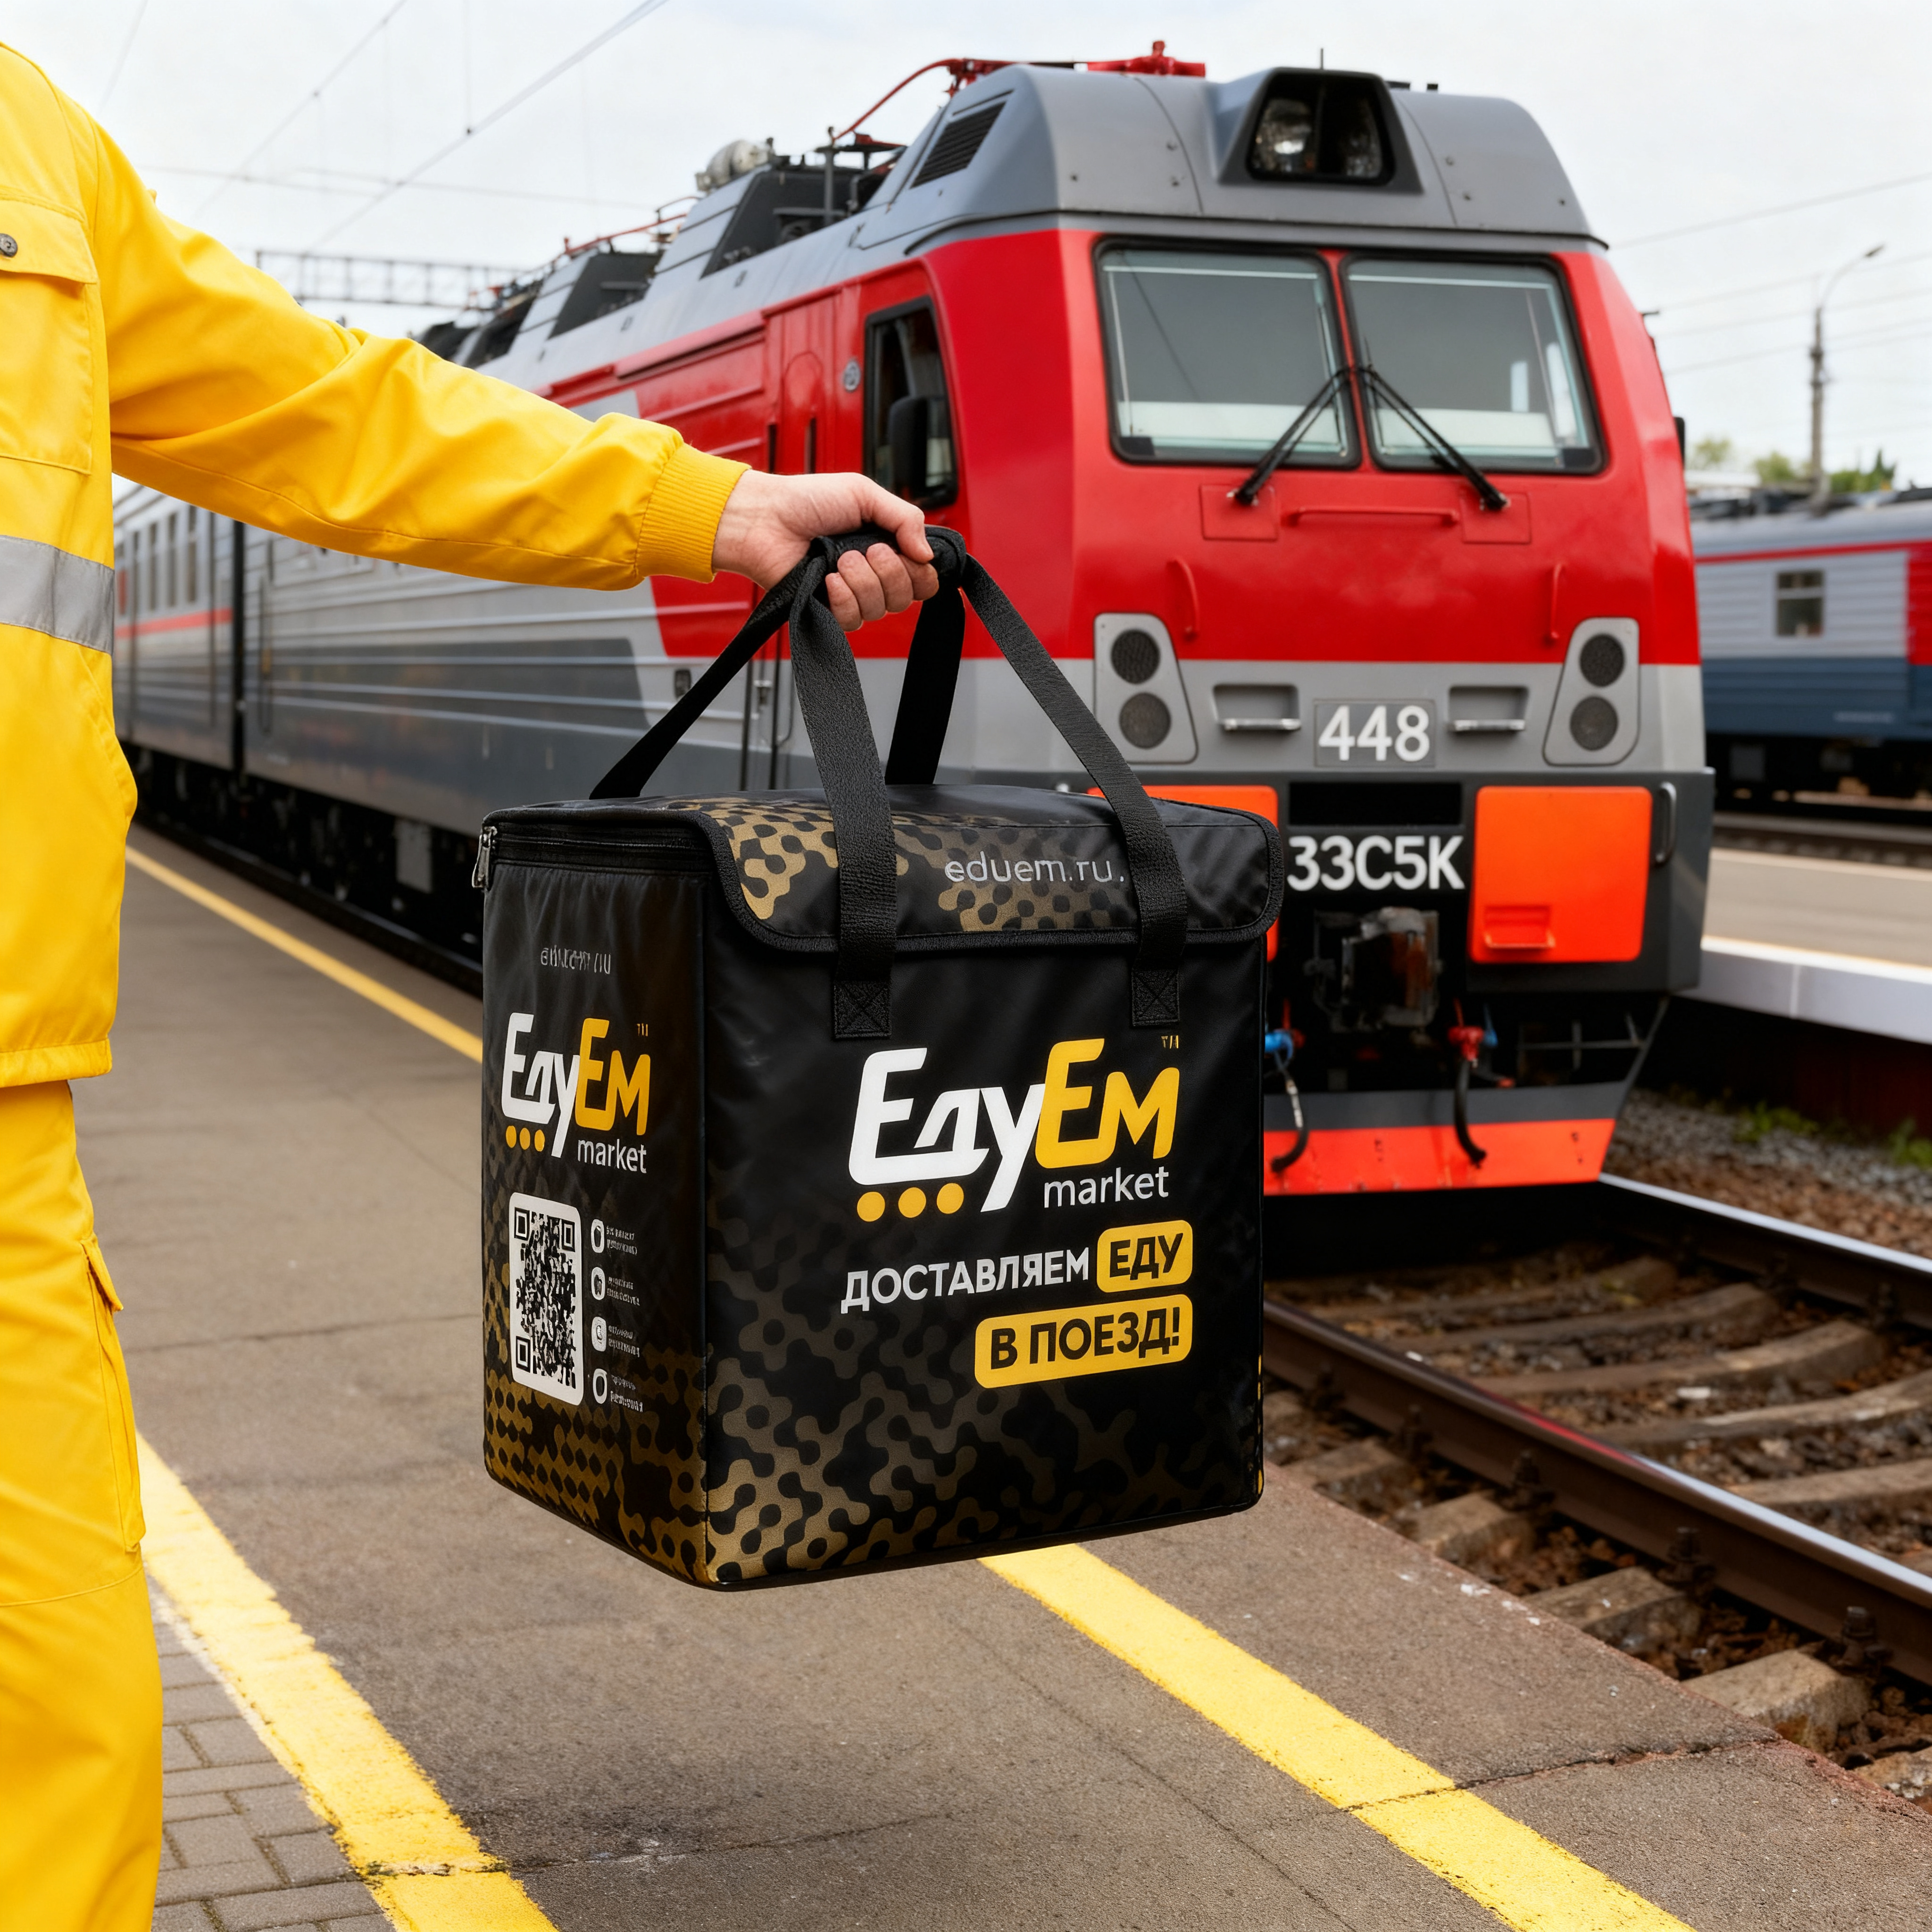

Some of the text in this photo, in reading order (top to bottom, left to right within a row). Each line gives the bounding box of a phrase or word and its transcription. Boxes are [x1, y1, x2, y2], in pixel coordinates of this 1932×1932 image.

[1319, 705, 1429, 761] 448
[577, 1138, 647, 1174] market
[1044, 1166, 1169, 1208] market
[841, 1232, 1183, 1314] ДОСТАВЛЯЕМ ЕДУ
[991, 1307, 1180, 1370] В ПОЕЗД!
